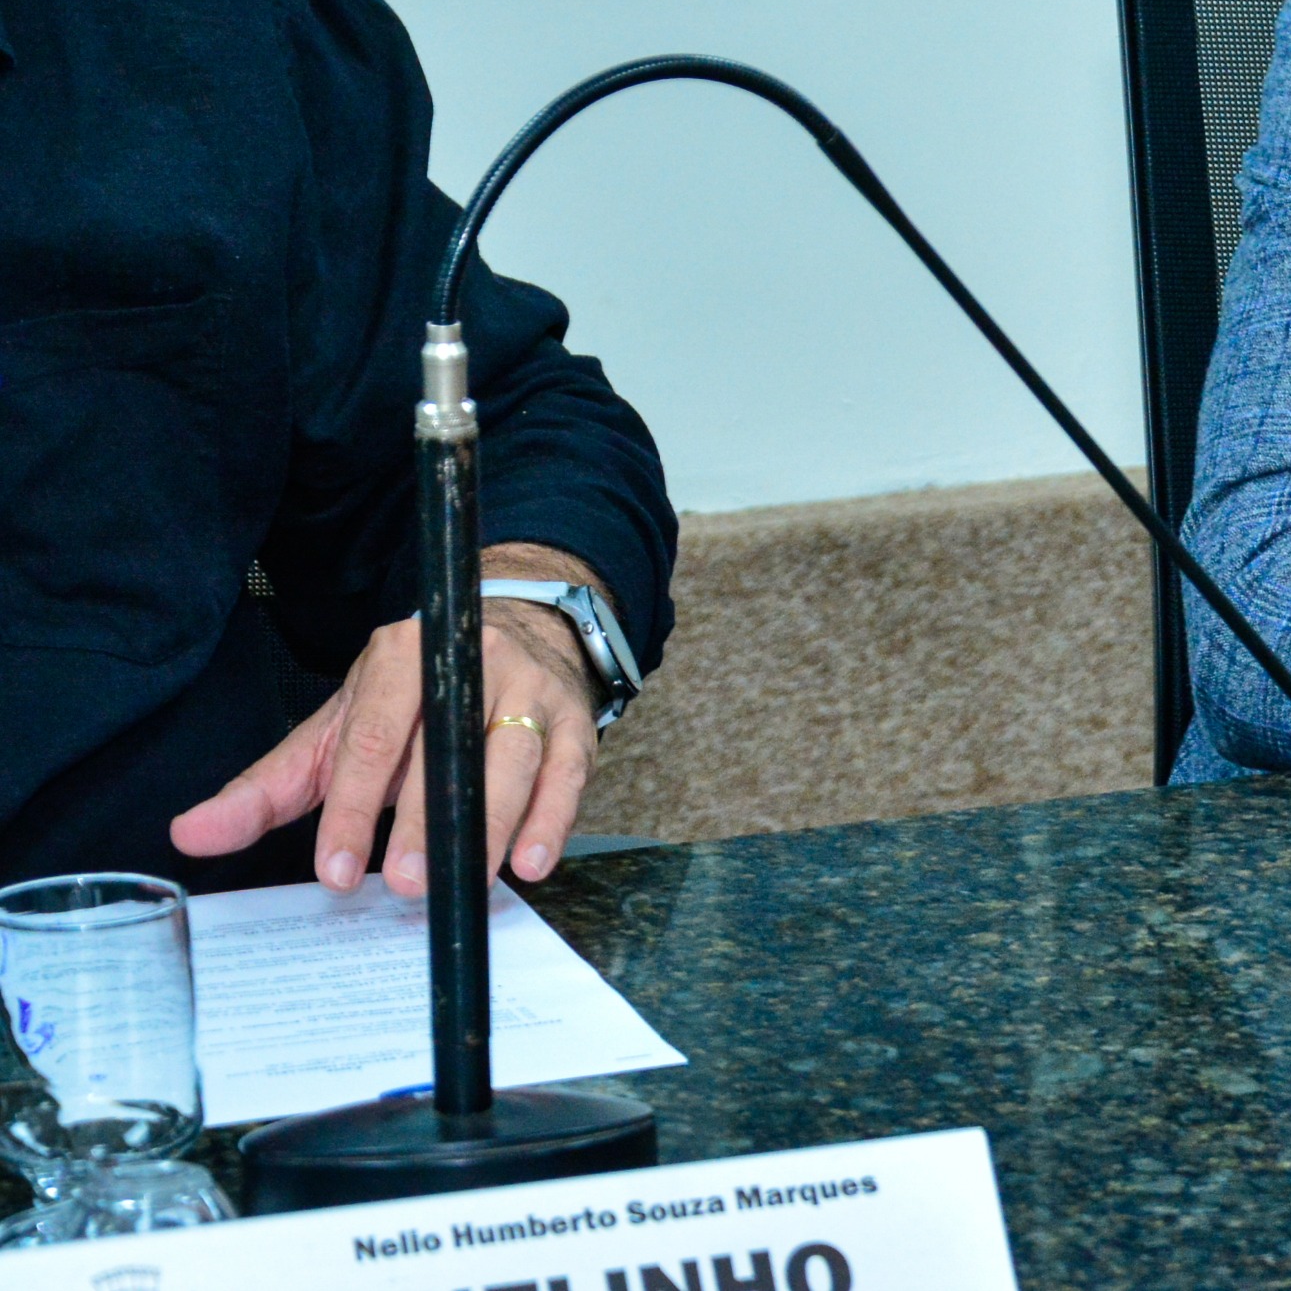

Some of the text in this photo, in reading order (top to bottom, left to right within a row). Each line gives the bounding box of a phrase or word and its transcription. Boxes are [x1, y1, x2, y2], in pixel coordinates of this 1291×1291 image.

[353, 1174, 879, 1261] Nelio Humberto Souza Marques
